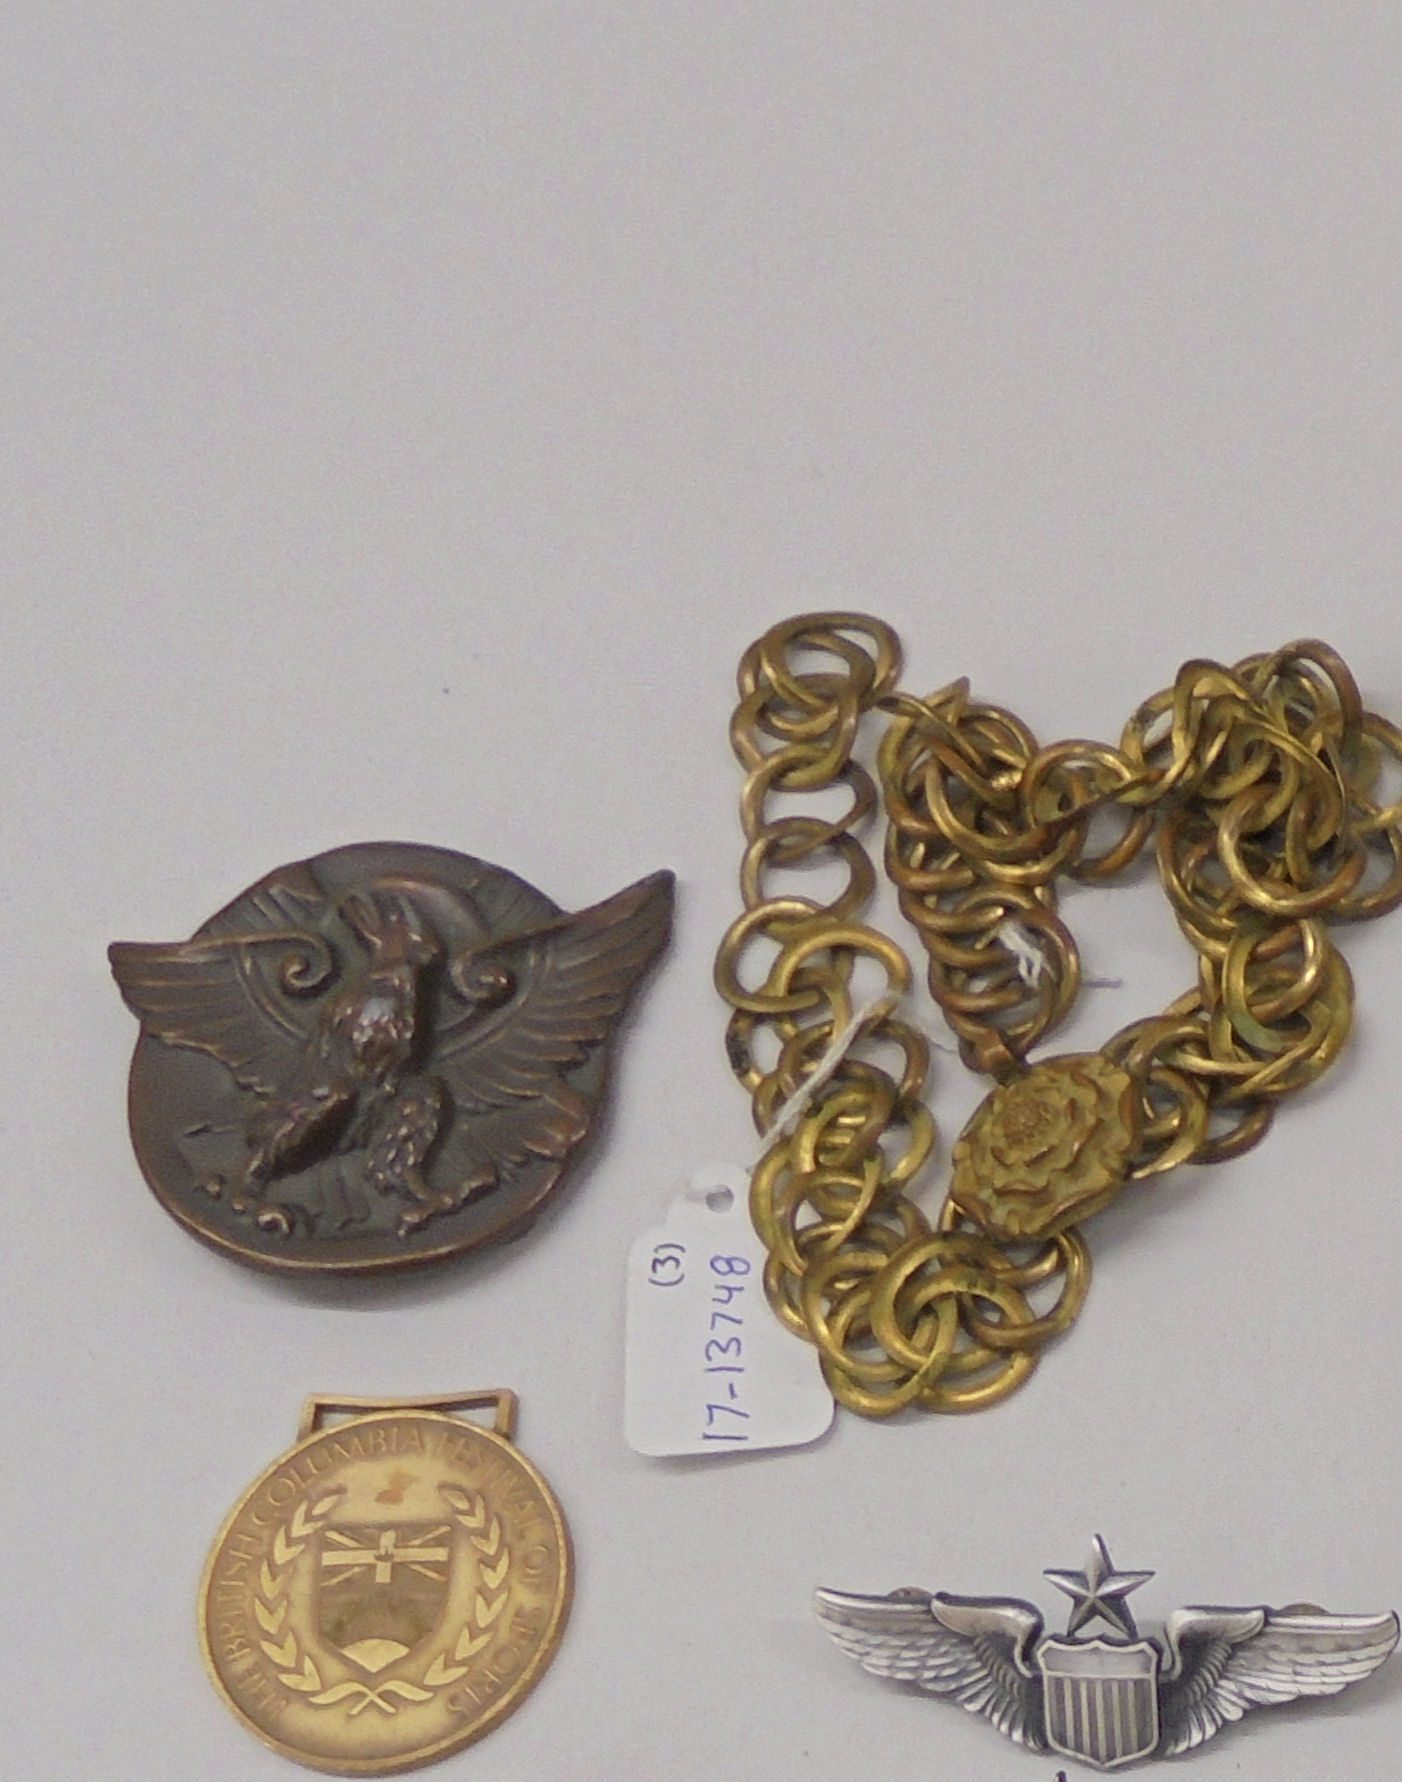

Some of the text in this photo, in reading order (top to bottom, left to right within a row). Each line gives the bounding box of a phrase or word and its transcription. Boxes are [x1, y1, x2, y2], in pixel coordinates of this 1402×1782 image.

[647, 1241, 686, 1287] (3)
[702, 1254, 752, 1441] 17-13748
[221, 1532, 259, 1663] BRITISH
[255, 1427, 426, 1533] COLUMBIA
